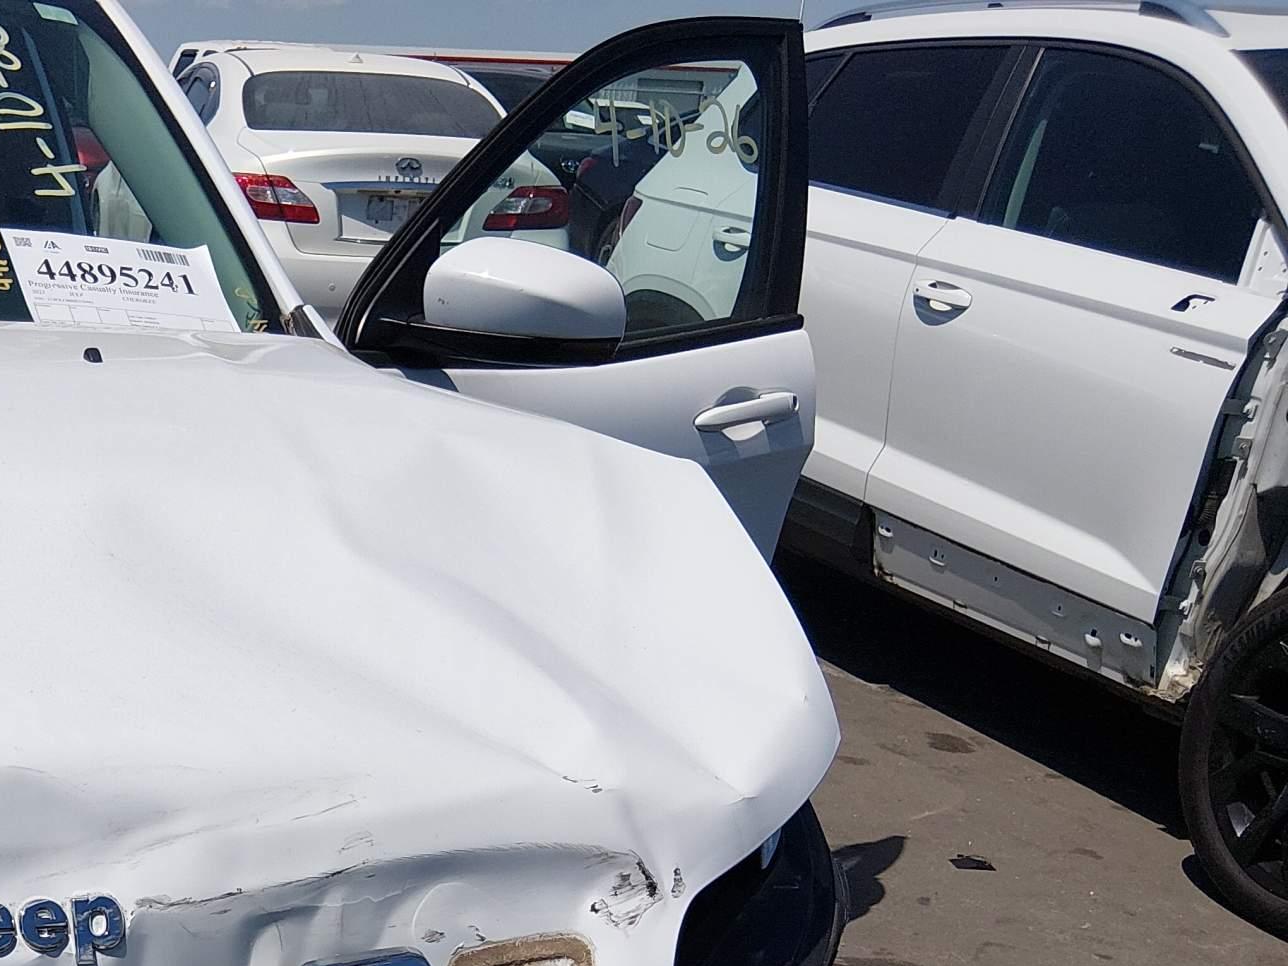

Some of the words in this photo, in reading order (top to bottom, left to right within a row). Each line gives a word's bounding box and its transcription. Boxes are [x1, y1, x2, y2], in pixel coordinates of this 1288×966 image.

[593, 92, 759, 168] 4-10-26
[28, 279, 78, 290] Progressive
[79, 283, 117, 295] Casualty
[118, 287, 159, 298] Insurance
[36, 258, 199, 296] 44895241
